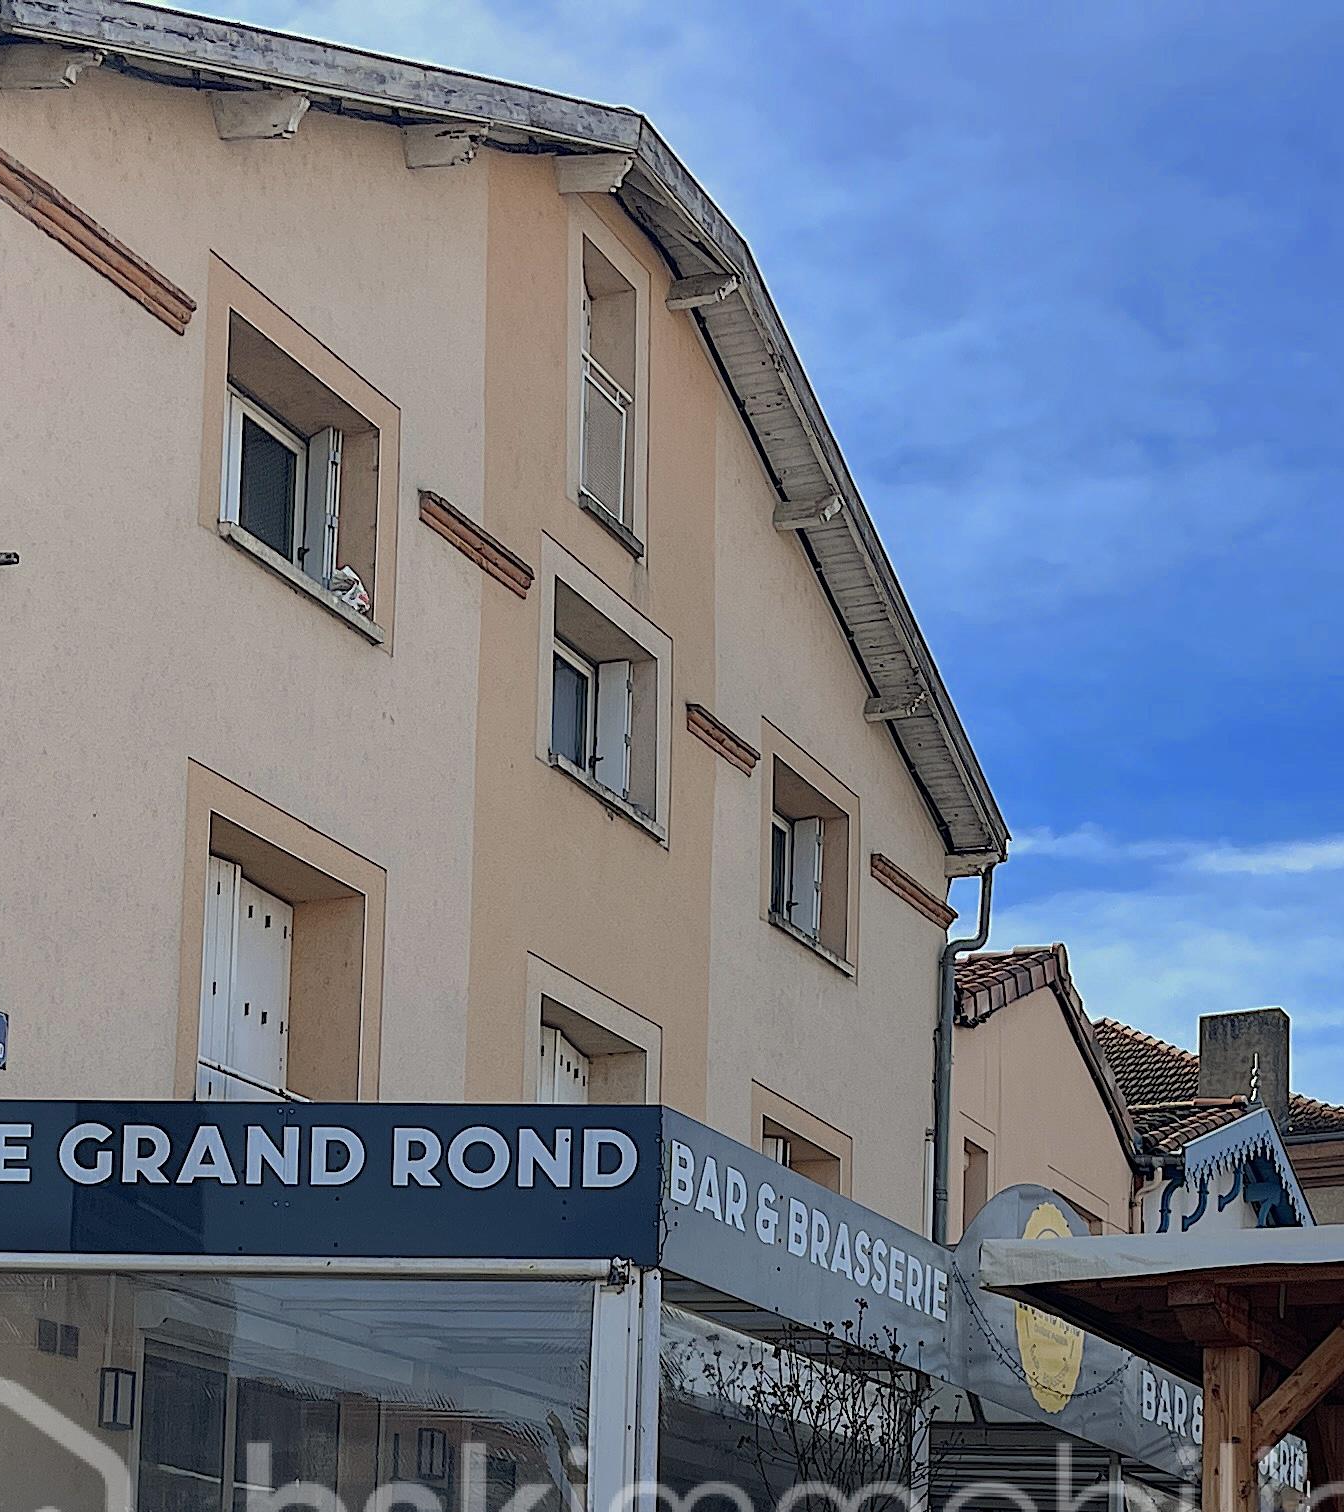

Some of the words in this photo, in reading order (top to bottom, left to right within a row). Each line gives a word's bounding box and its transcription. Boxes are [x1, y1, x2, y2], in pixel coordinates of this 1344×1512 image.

[57, 1122, 367, 1186] GRAND
[391, 1125, 639, 1190] ROND
[669, 1139, 748, 1233] BAR
[755, 1182, 779, 1245] &
[787, 1196, 948, 1323] BRASSERIE
[1142, 1369, 1188, 1438] BAR
